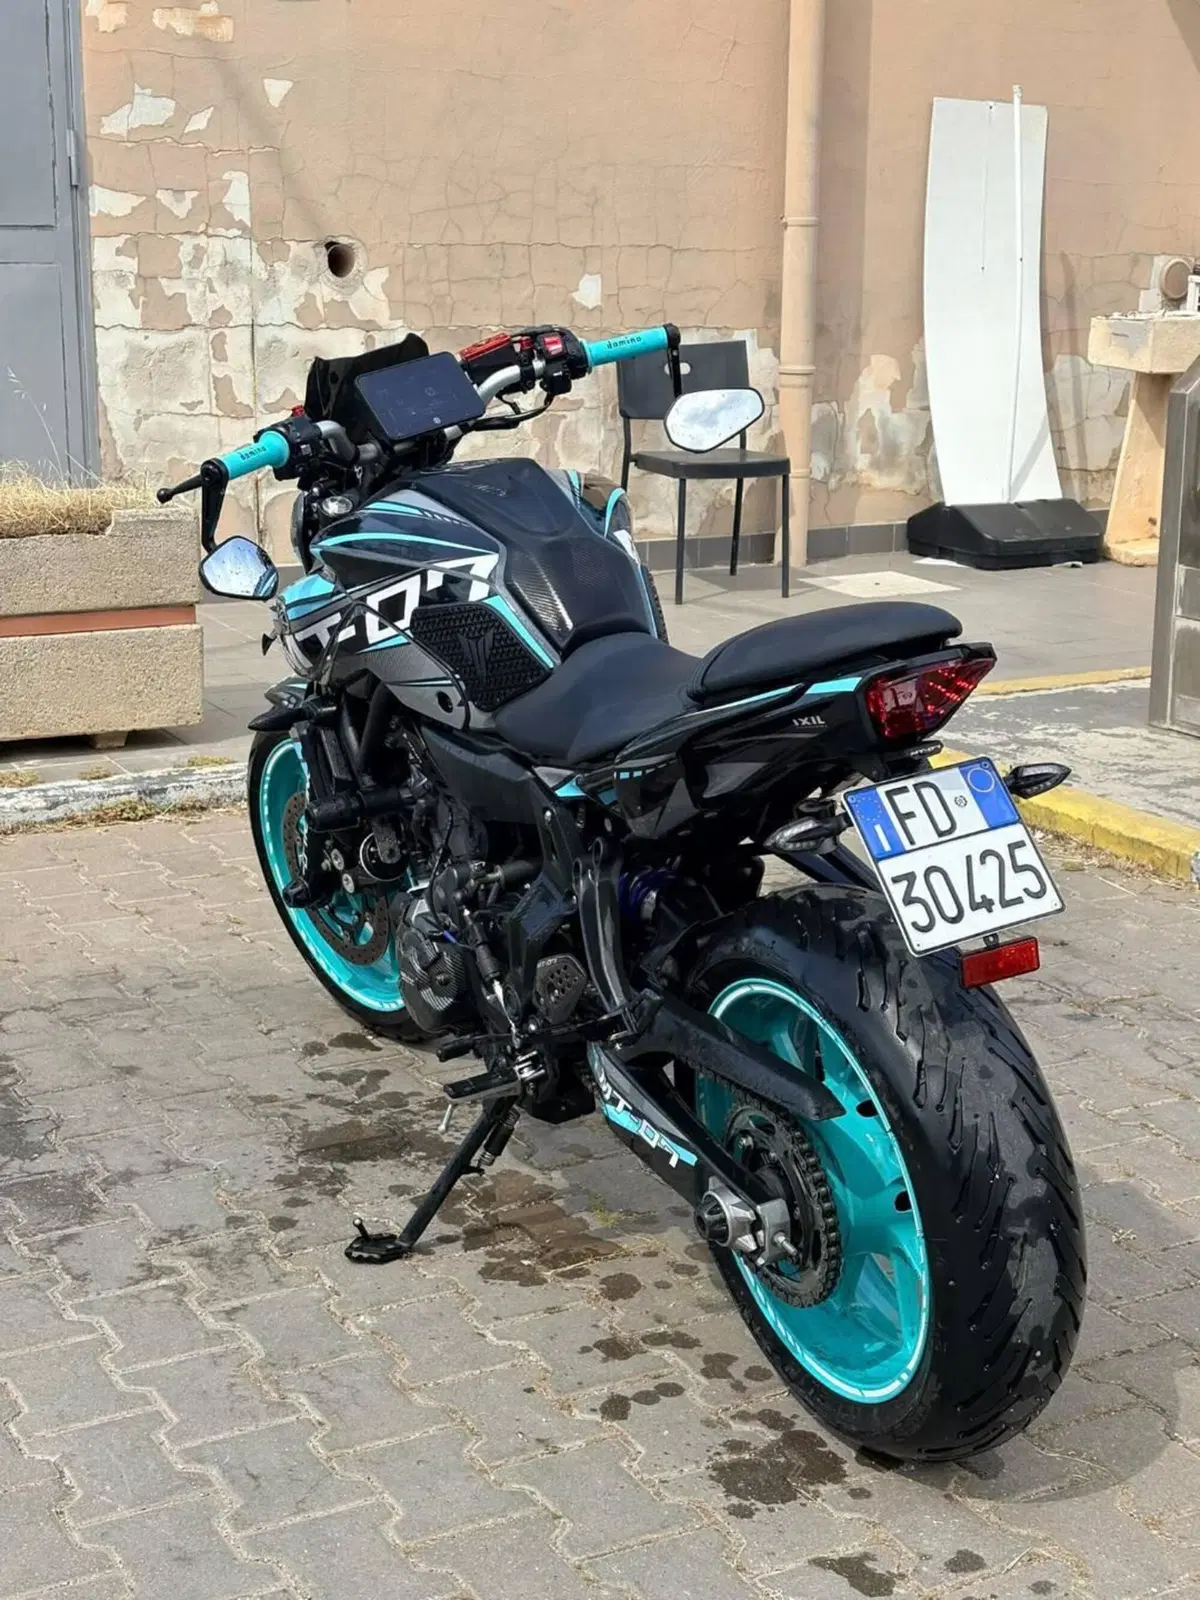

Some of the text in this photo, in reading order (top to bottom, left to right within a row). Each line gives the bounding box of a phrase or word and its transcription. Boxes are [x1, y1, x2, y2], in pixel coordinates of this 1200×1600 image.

[606, 335, 642, 349] domino
[240, 446, 267, 460] domino
[792, 715, 825, 726] IXIL
[885, 781, 957, 845] FD
[891, 840, 1047, 933] 30425
